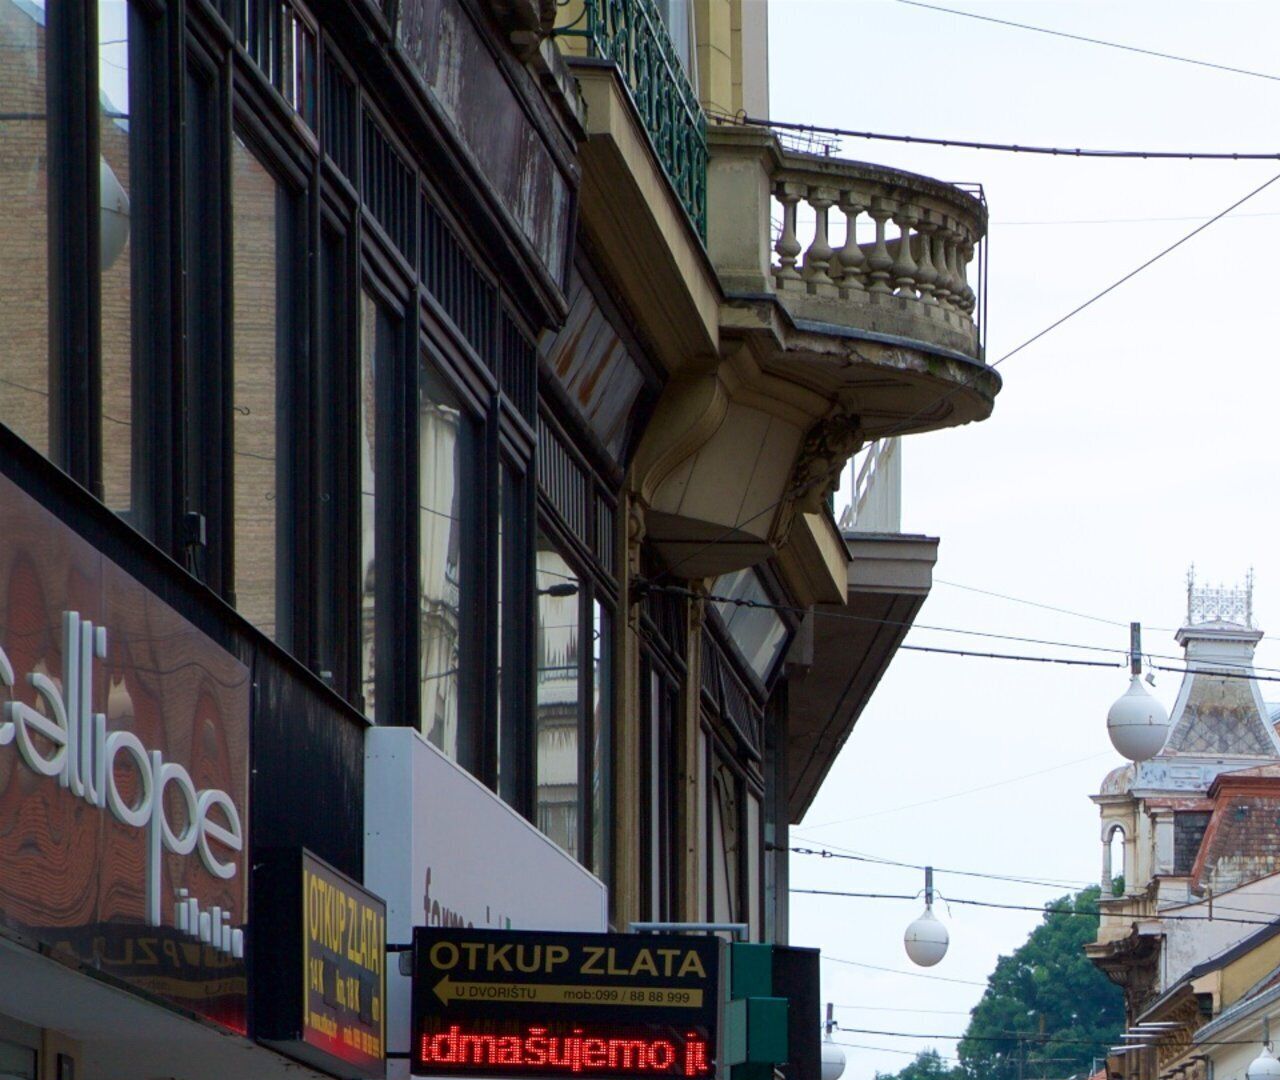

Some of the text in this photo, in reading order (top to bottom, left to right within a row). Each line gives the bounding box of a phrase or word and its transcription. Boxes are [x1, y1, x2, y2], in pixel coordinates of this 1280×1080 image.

[309, 873, 346, 954] OTKUP
[347, 896, 379, 975] ZLATA
[429, 941, 707, 978] OTKUP ZLATA
[455, 986, 466, 998] U
[469, 984, 537, 999] DVORIŠTU
[667, 991, 690, 1003] 999
